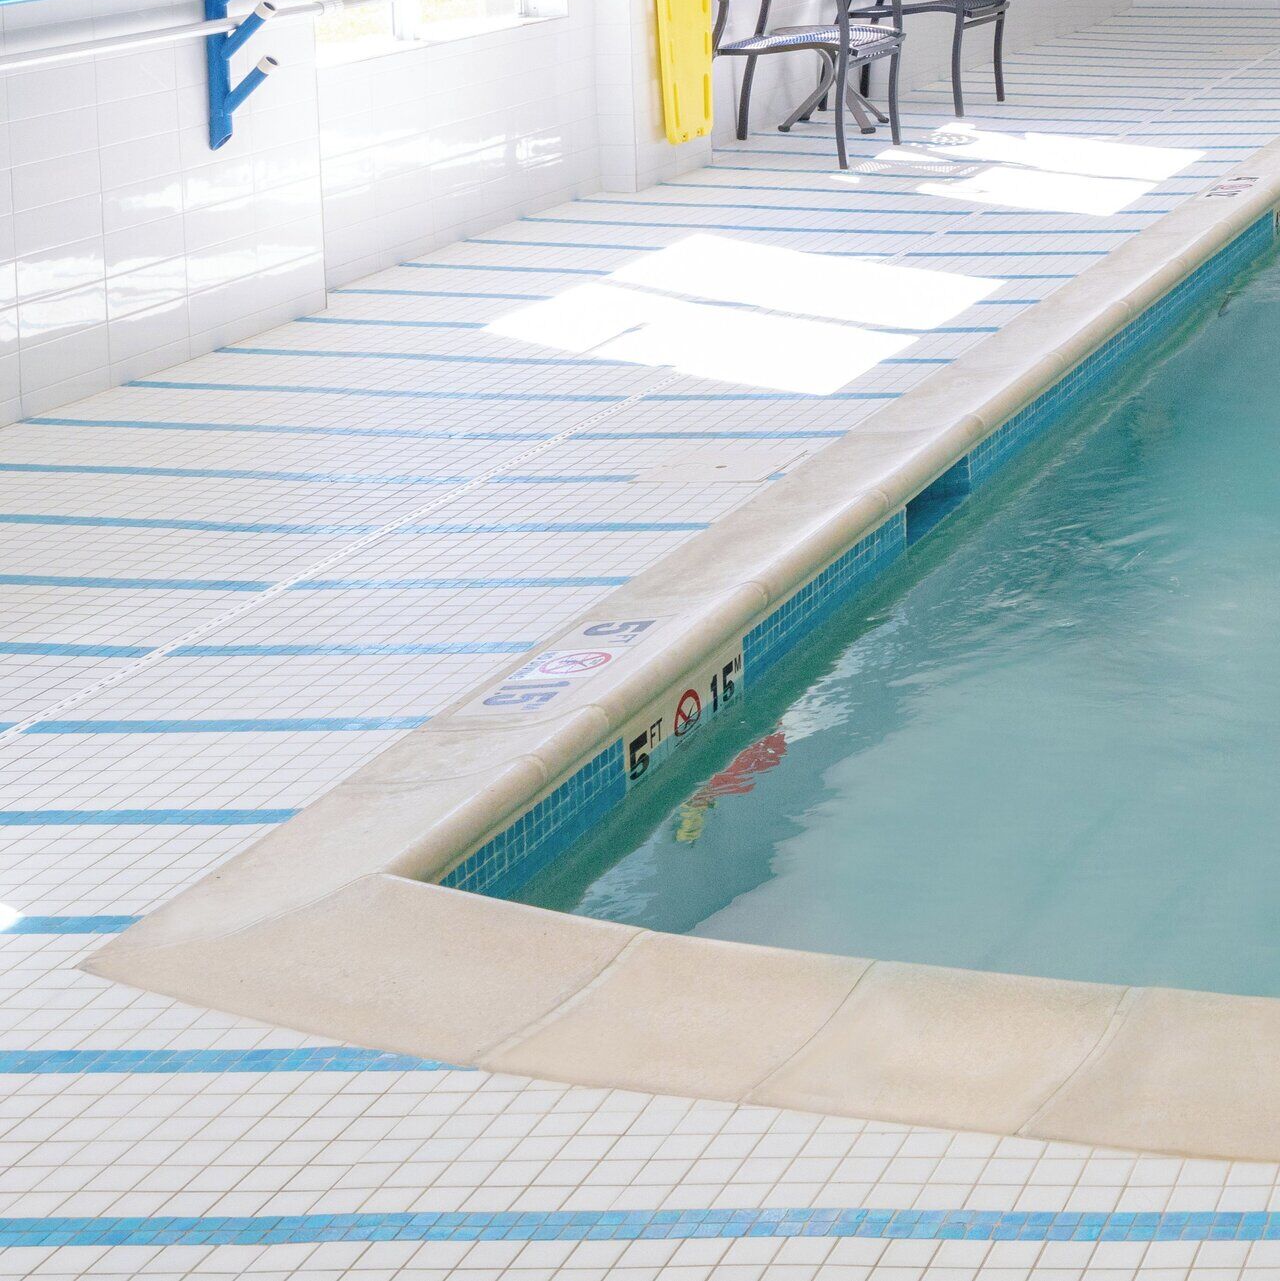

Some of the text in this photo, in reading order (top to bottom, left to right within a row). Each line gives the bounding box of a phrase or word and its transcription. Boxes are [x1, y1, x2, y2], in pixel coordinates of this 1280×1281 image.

[583, 620, 657, 636] 5
[629, 730, 650, 780] 5
[650, 717, 662, 749] FT
